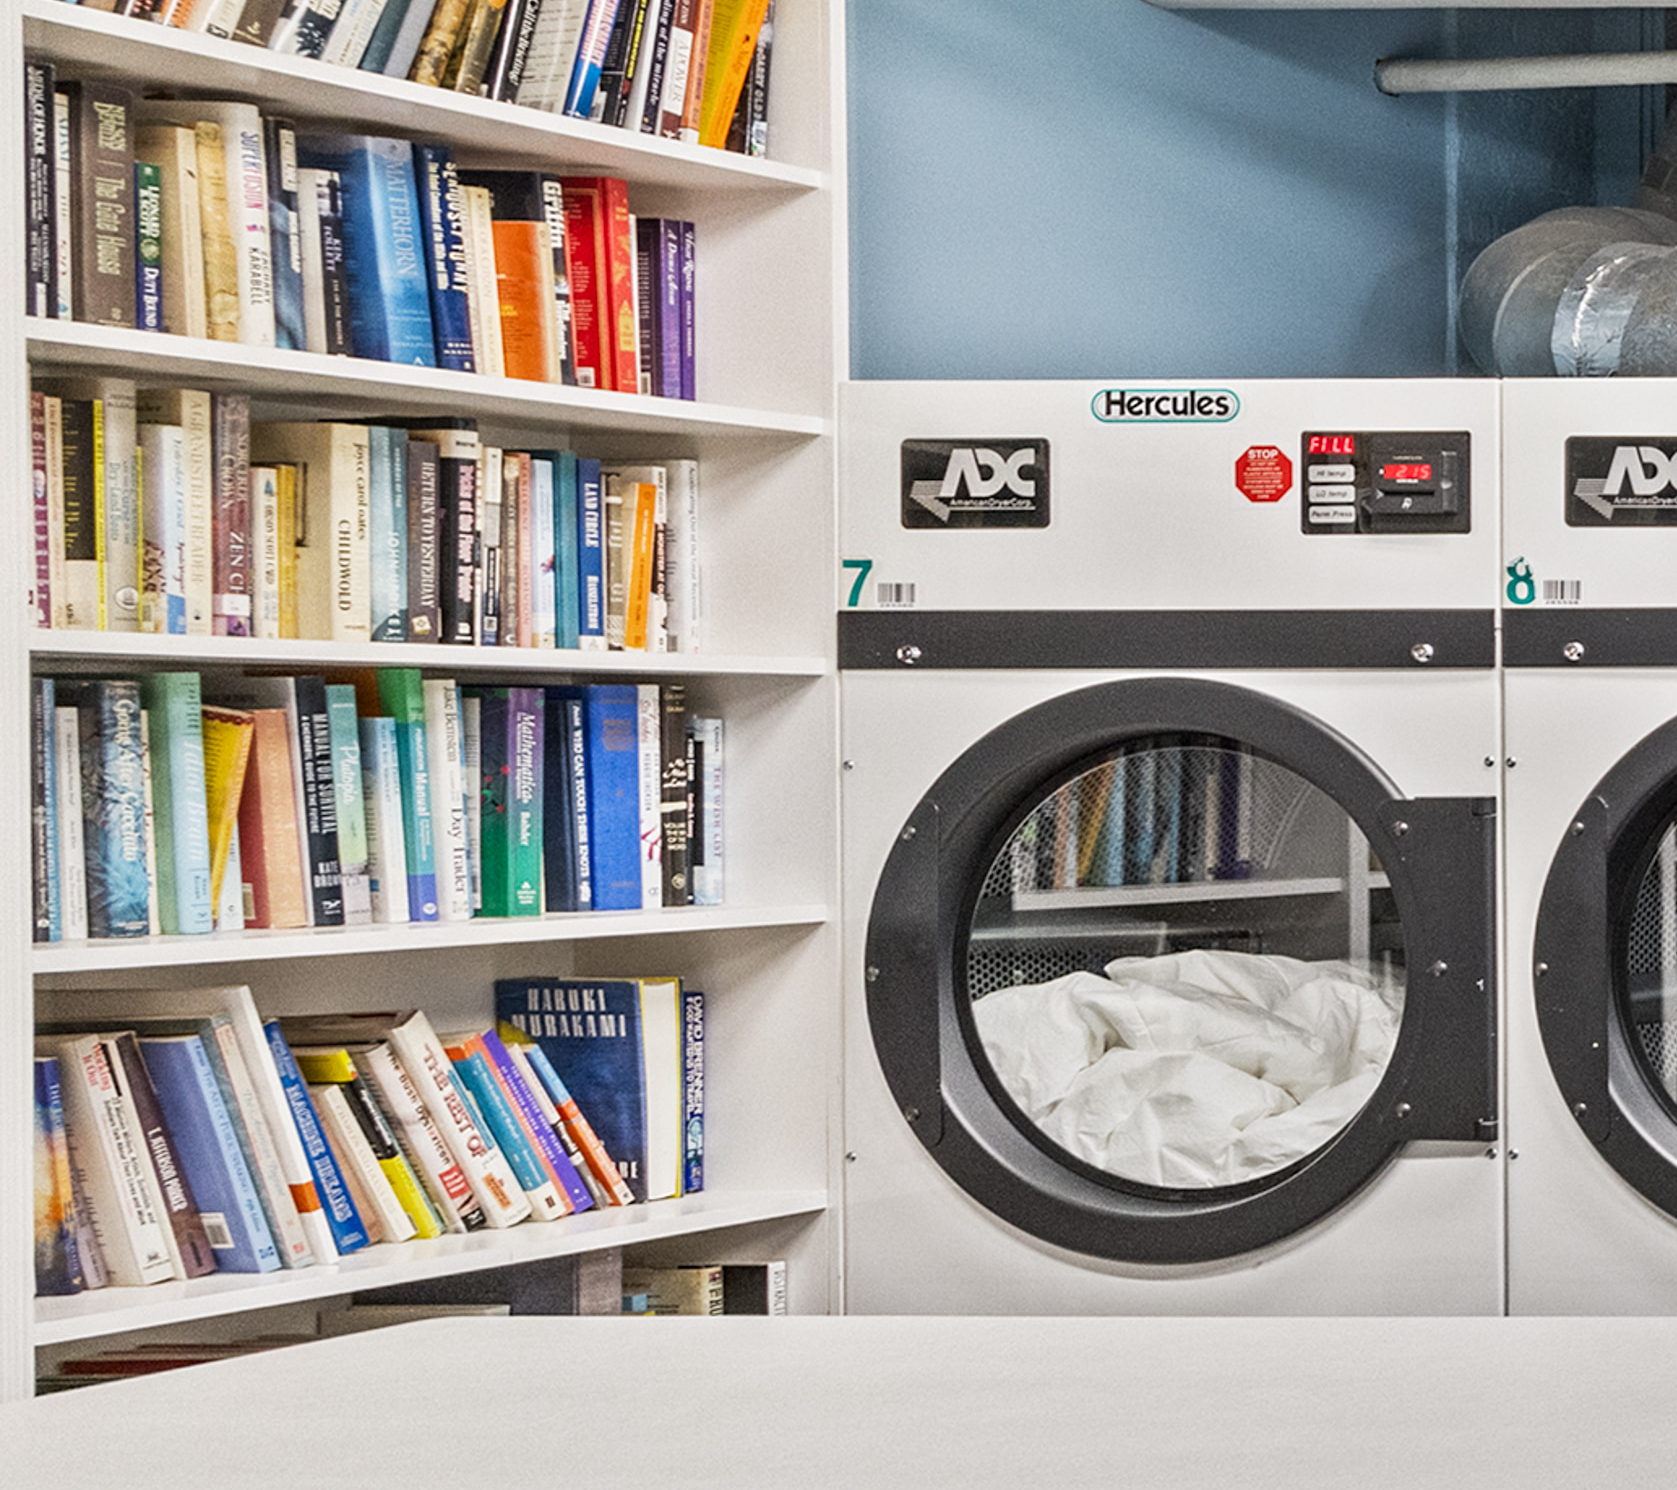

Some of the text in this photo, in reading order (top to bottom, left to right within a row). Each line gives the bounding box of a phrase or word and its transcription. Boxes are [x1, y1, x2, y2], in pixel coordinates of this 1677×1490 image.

[96, 177, 127, 276] The Gate House
[385, 161, 417, 276] MATTERHORN
[543, 180, 565, 248] Griffin
[1104, 390, 1230, 417] Hercules
[941, 448, 1035, 497] ADC
[1248, 449, 1278, 459] STOP
[353, 443, 367, 541] joyce carol oates
[421, 461, 435, 514] RETURN
[229, 532, 244, 564] ZEN
[338, 519, 351, 611] CHILDWOLD
[420, 534, 435, 609] YESTERDAY
[843, 559, 873, 607] 7
[1506, 557, 1536, 605] 8
[112, 699, 134, 746] Going
[117, 749, 136, 788] After
[313, 714, 337, 834] MANUAL FOR SURVIVAL
[340, 740, 360, 806] Plutopia
[450, 809, 465, 894] Day Trader
[512, 1015, 626, 1037] MURAKAMI
[528, 989, 605, 1011] HARUKI
[692, 995, 704, 1115] DAVID BRENNER
[446, 1088, 477, 1134] REST
[466, 1134, 487, 1159] OF
